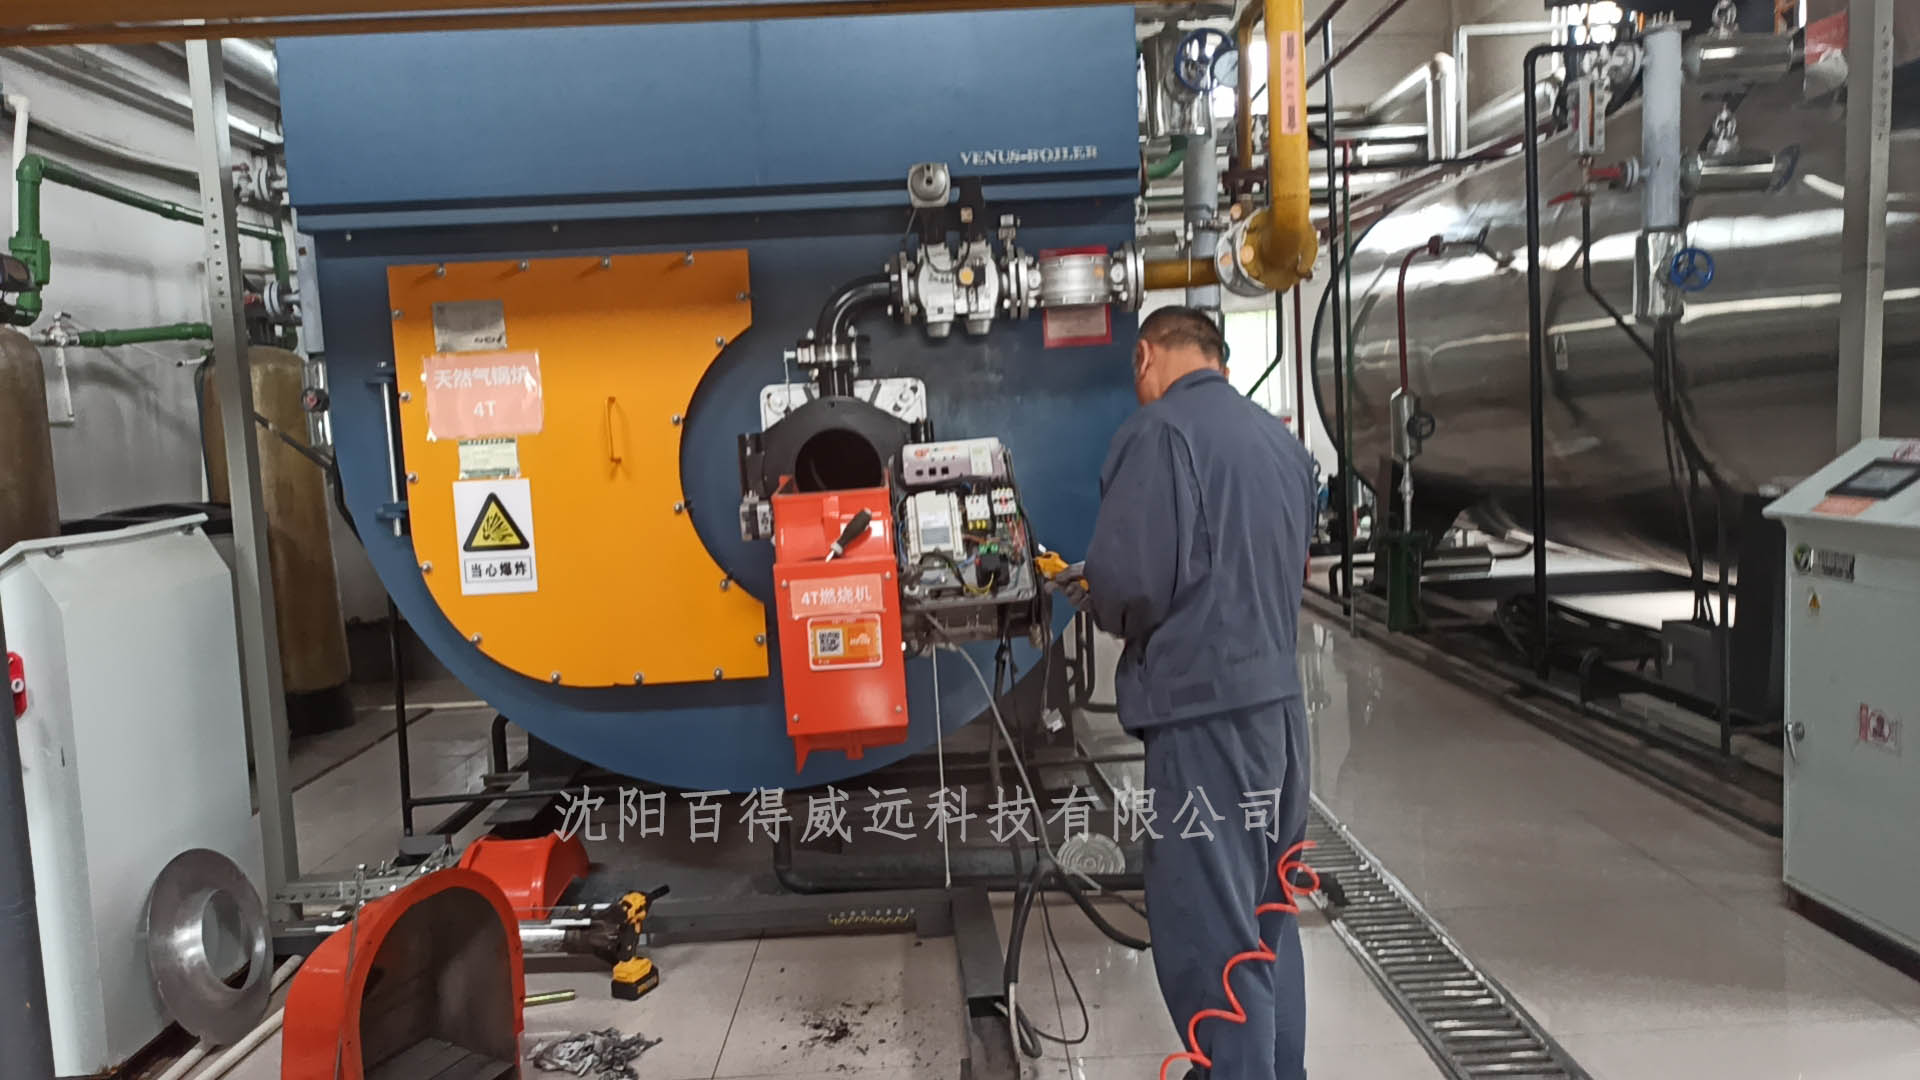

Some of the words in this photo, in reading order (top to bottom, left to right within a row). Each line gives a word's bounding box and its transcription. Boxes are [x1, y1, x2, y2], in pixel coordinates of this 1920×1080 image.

[473, 401, 496, 417] 4T
[471, 561, 527, 578] 当心爆炸
